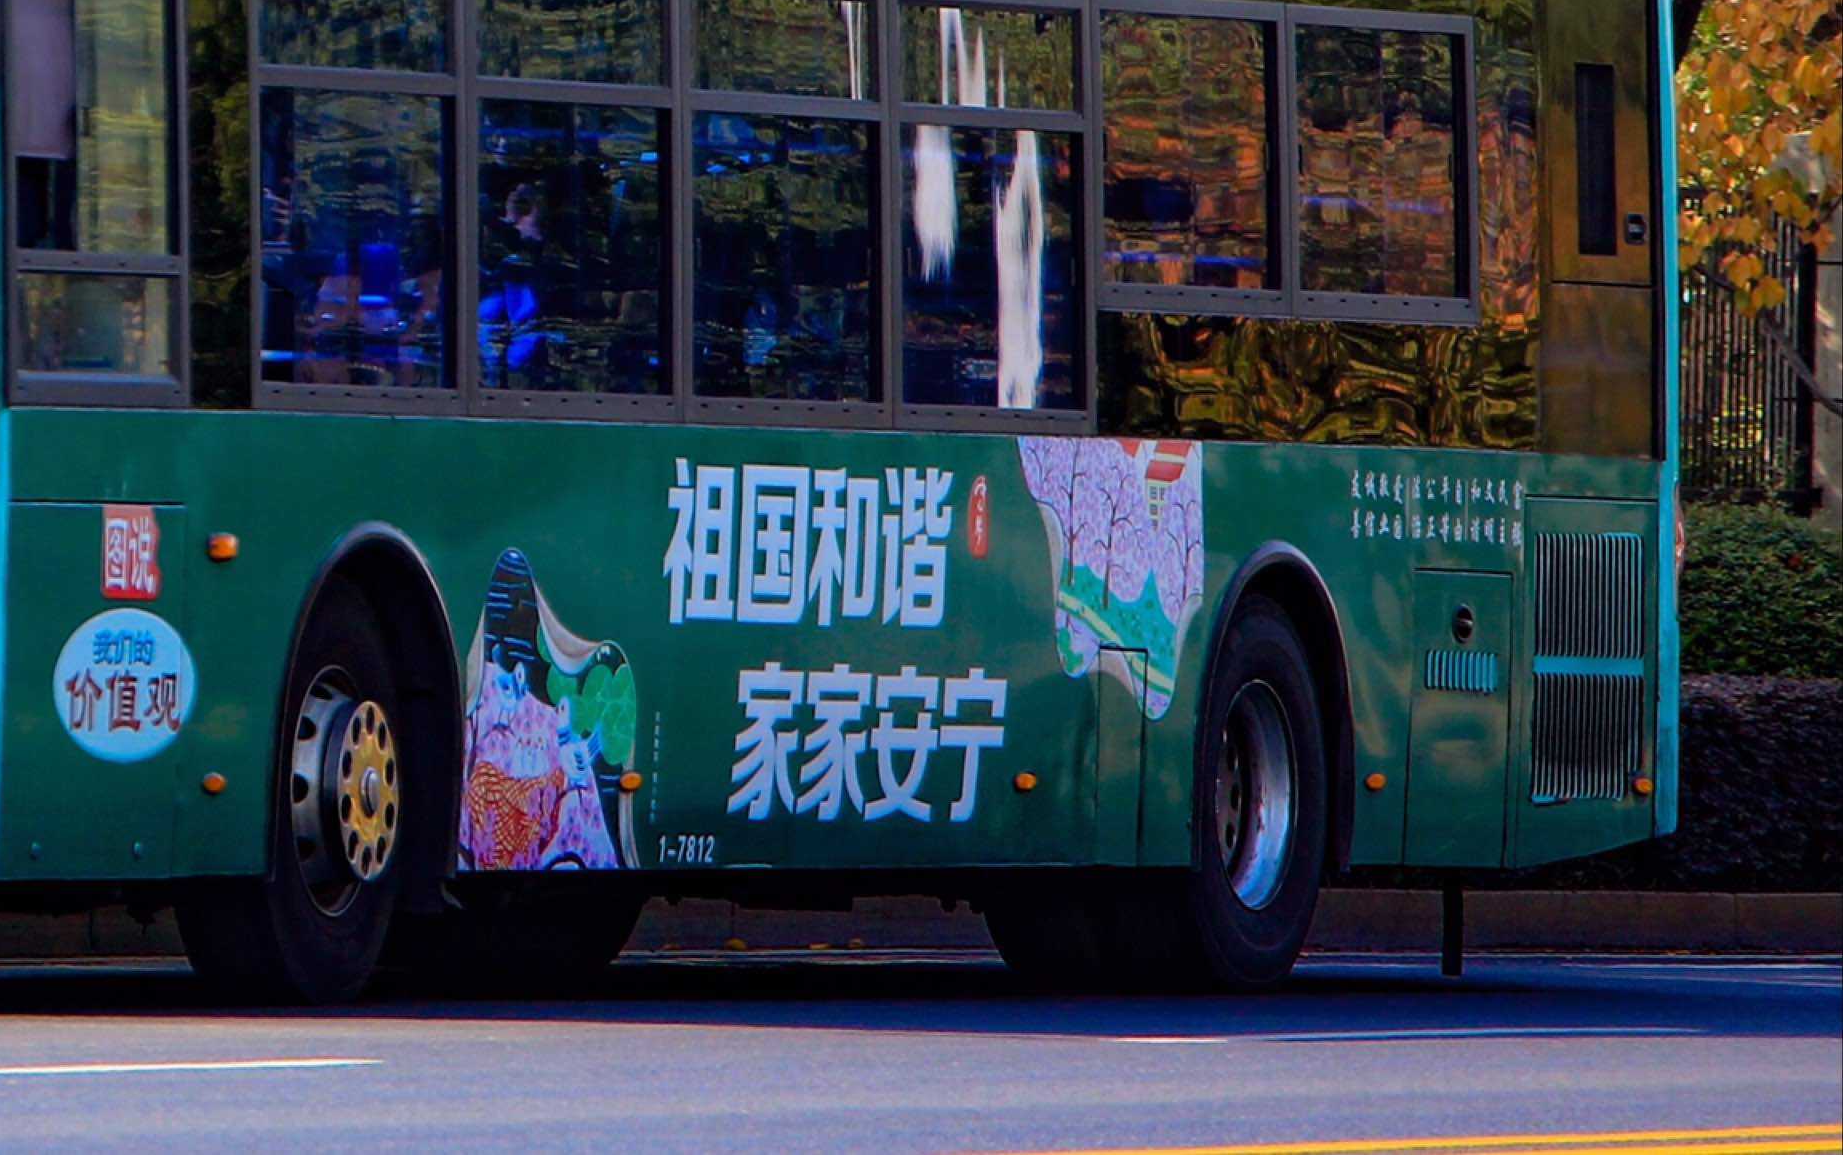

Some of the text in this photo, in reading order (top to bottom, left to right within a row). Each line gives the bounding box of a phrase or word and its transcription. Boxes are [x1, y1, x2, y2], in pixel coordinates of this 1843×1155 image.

[105, 517, 156, 593] 图说
[663, 457, 953, 626] 祖国和谐
[93, 630, 154, 664] 我们的
[65, 668, 182, 732] 价值观
[727, 662, 1007, 822] 家家安宁
[658, 835, 715, 864] 1-7812
